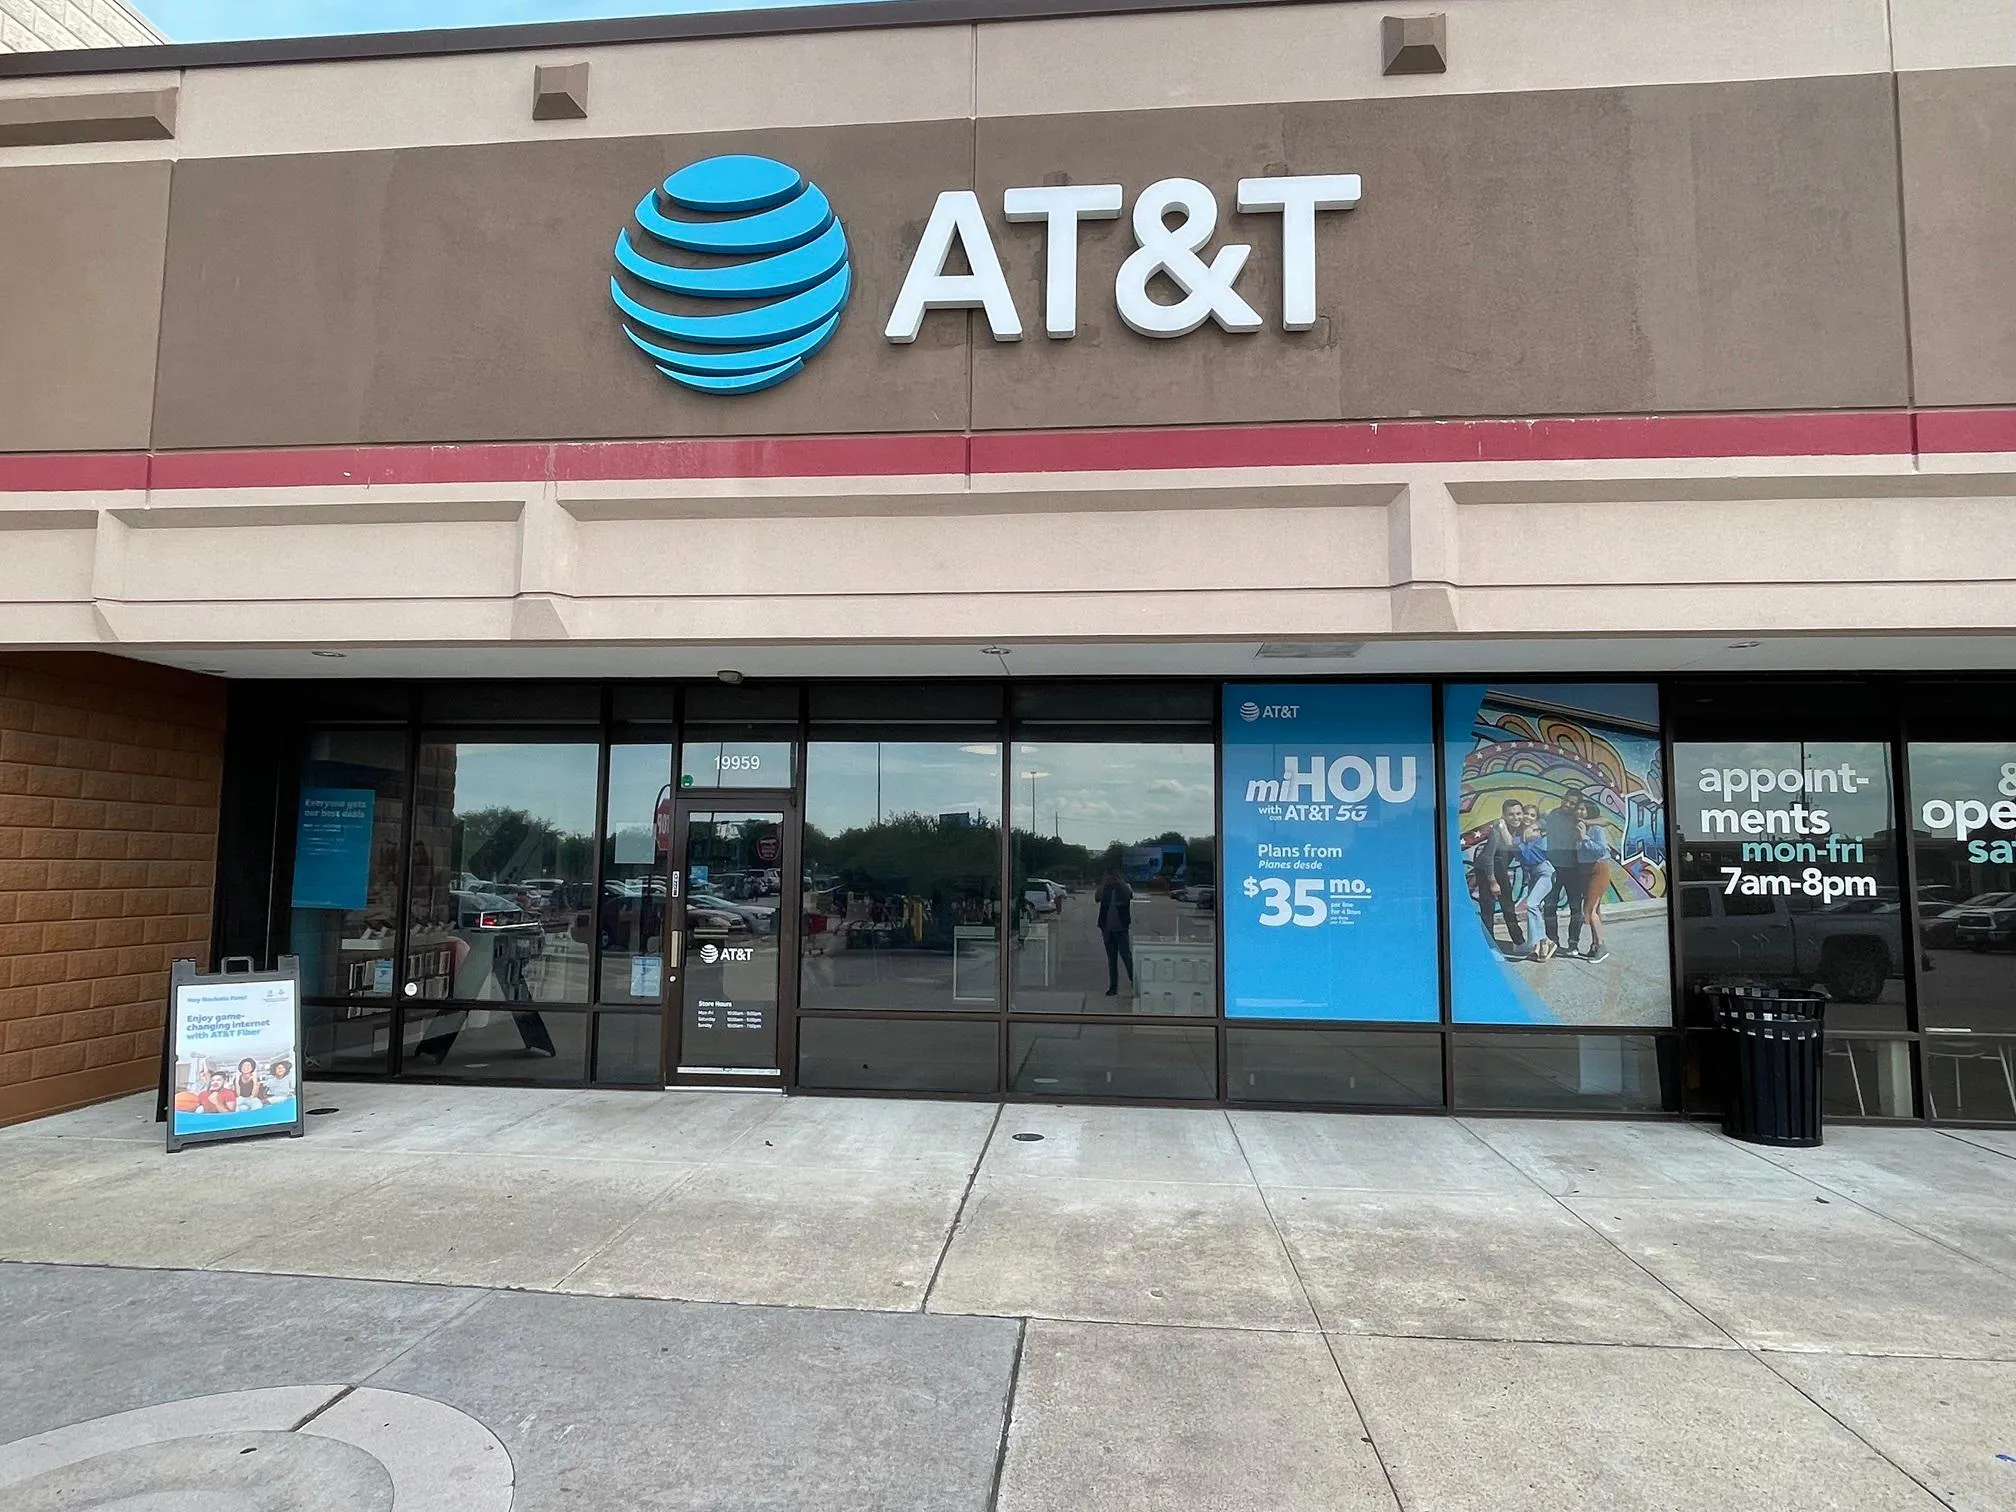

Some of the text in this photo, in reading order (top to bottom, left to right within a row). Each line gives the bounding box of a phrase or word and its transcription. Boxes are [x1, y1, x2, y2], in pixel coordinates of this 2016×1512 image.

[884, 173, 1362, 343] AT&T
[1262, 705, 1300, 719] AT&T
[714, 755, 760, 770] 19959
[1698, 763, 1870, 803] appoint-
[1257, 805, 1368, 821] with AT&T 5G
[1701, 803, 1831, 835] ments
[1258, 844, 1342, 858] Plans from
[1741, 833, 1864, 863] mon-fri
[1968, 839, 2016, 863] sa
[1258, 860, 1323, 870] Planes desde
[1330, 879, 1372, 893] mo.
[1720, 867, 1877, 904] 7am-8pm
[720, 947, 754, 960] AT&T
[187, 1013, 245, 1024] Enjoy game-
[186, 1021, 231, 1031] changing
[186, 1028, 261, 1040] with AT&T Fiber
